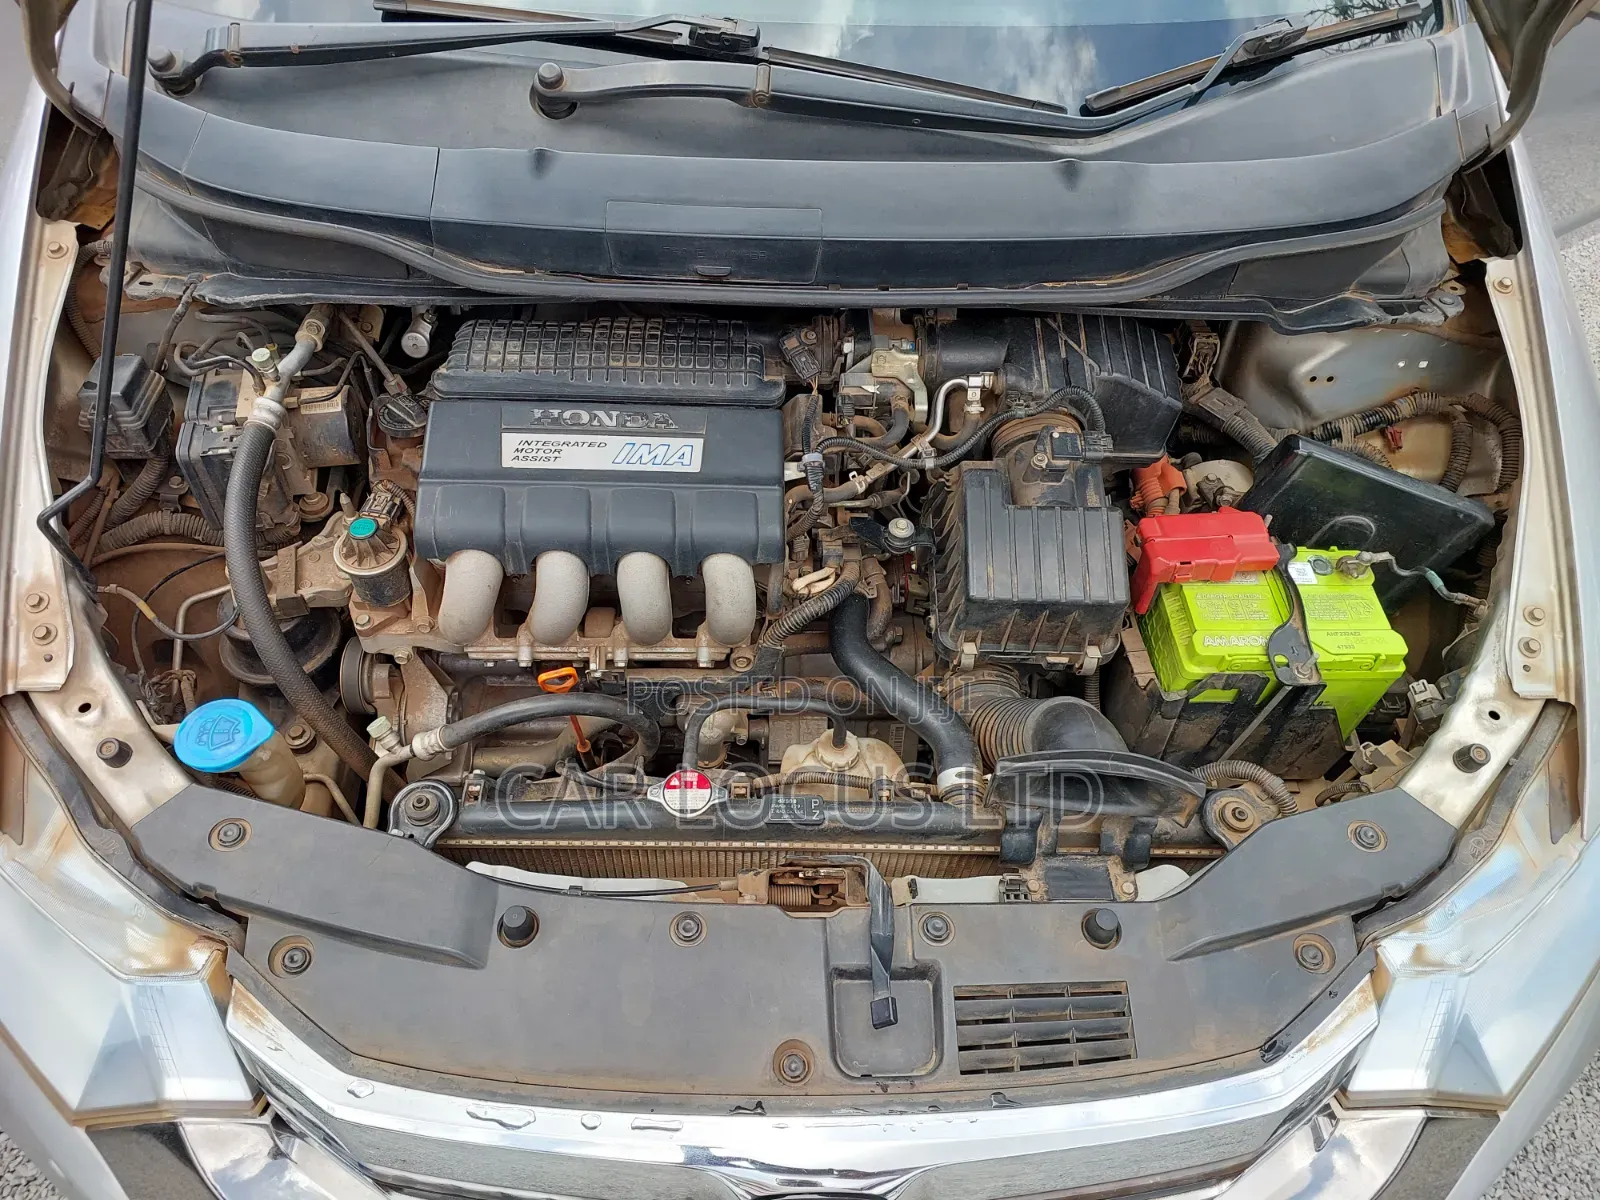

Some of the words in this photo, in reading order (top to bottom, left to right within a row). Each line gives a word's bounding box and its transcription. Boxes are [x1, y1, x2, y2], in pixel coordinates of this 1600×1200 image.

[529, 408, 679, 430] HONDA
[517, 439, 608, 448] INTEGRATED
[513, 447, 563, 455] MOTOR
[612, 442, 694, 466] IMA
[511, 455, 562, 463] ASSIST
[811, 799, 820, 809] P
[812, 810, 820, 820] Z
